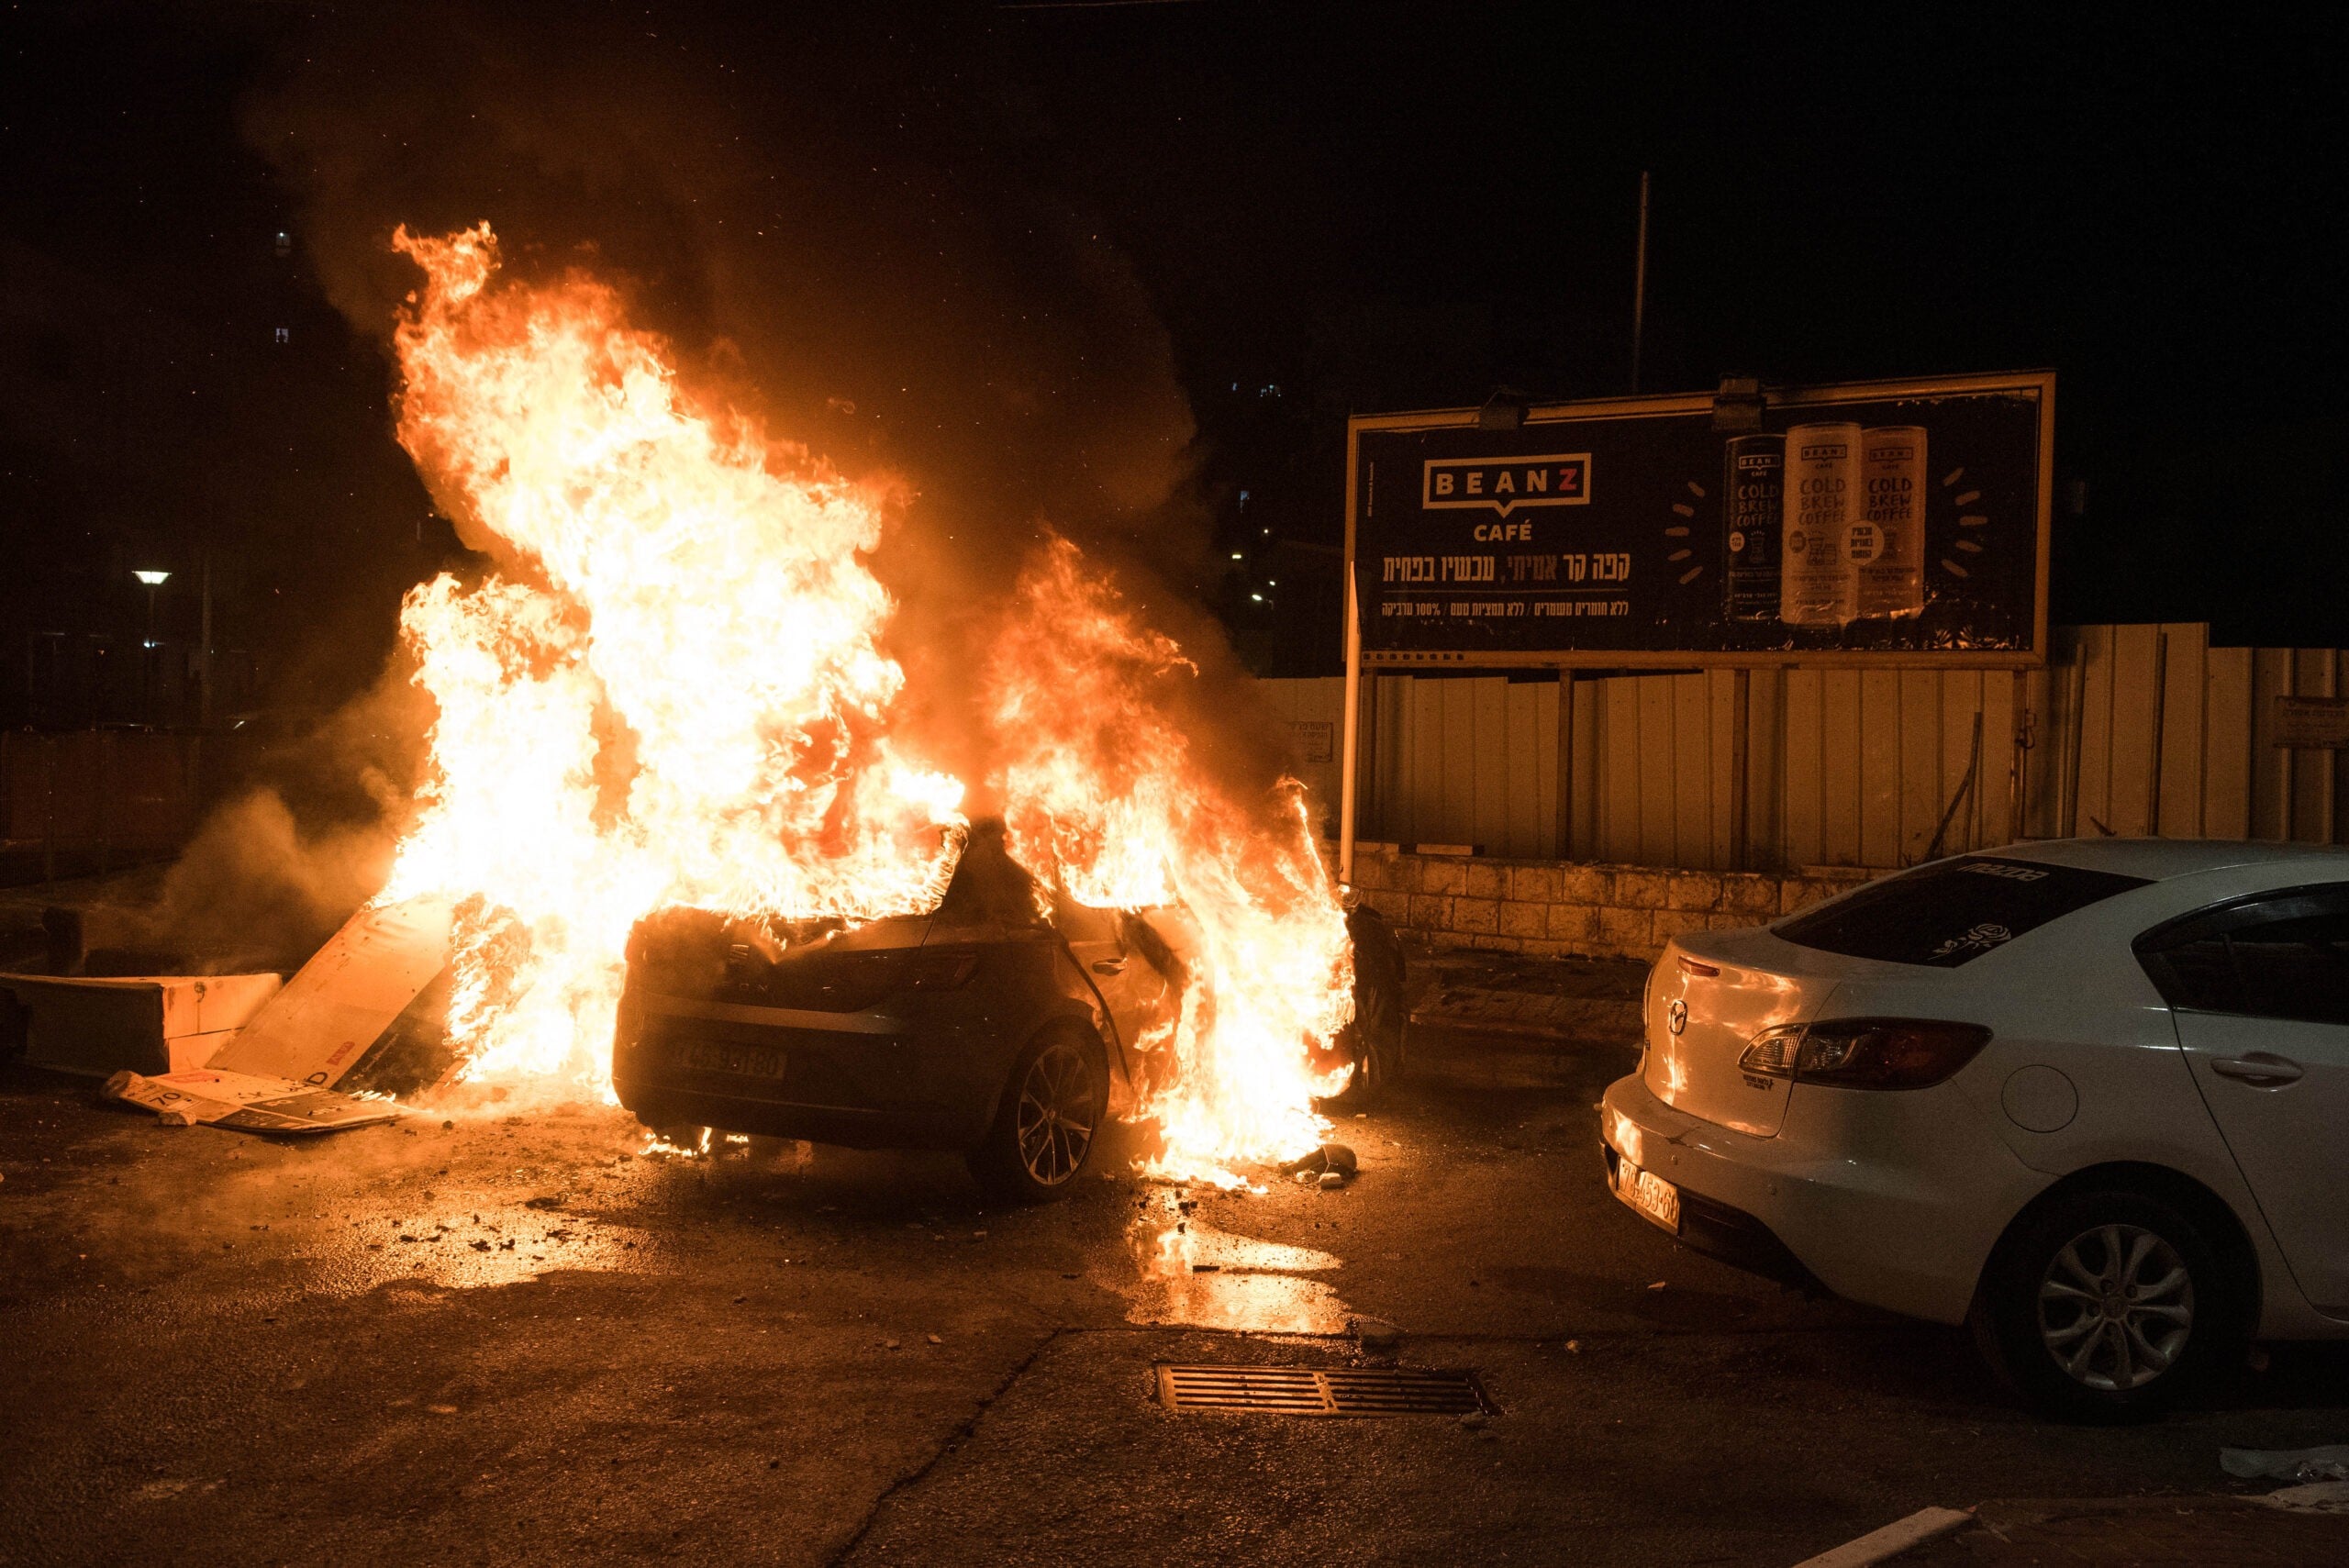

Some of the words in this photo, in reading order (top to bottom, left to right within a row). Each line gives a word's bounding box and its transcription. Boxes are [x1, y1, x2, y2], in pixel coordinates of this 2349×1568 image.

[1435, 467, 1578, 495] BEANZ
[1799, 475, 1846, 495] COLD
[1868, 477, 1912, 494] COLD
[1737, 484, 1779, 500] COLD
[1869, 493, 1912, 507] BREW
[1800, 495, 1845, 511] BREW
[1866, 506, 1912, 522] COFFEE
[1473, 518, 1532, 542] CAFÉ
[1383, 556, 1435, 582] בפחית
[1441, 556, 1495, 582] עכשיו
[1563, 553, 1586, 583] קר
[1592, 553, 1631, 582] קפה
[1382, 602, 1413, 617] ערביקה
[1415, 602, 1441, 617] 100%
[1450, 602, 1469, 617] טעם
[1472, 602, 1505, 617] תמציות
[1506, 602, 1524, 617] ללא
[1534, 602, 1573, 617] משמרים
[1575, 602, 1608, 617] חומרים
[1609, 600, 1630, 617] ללא
